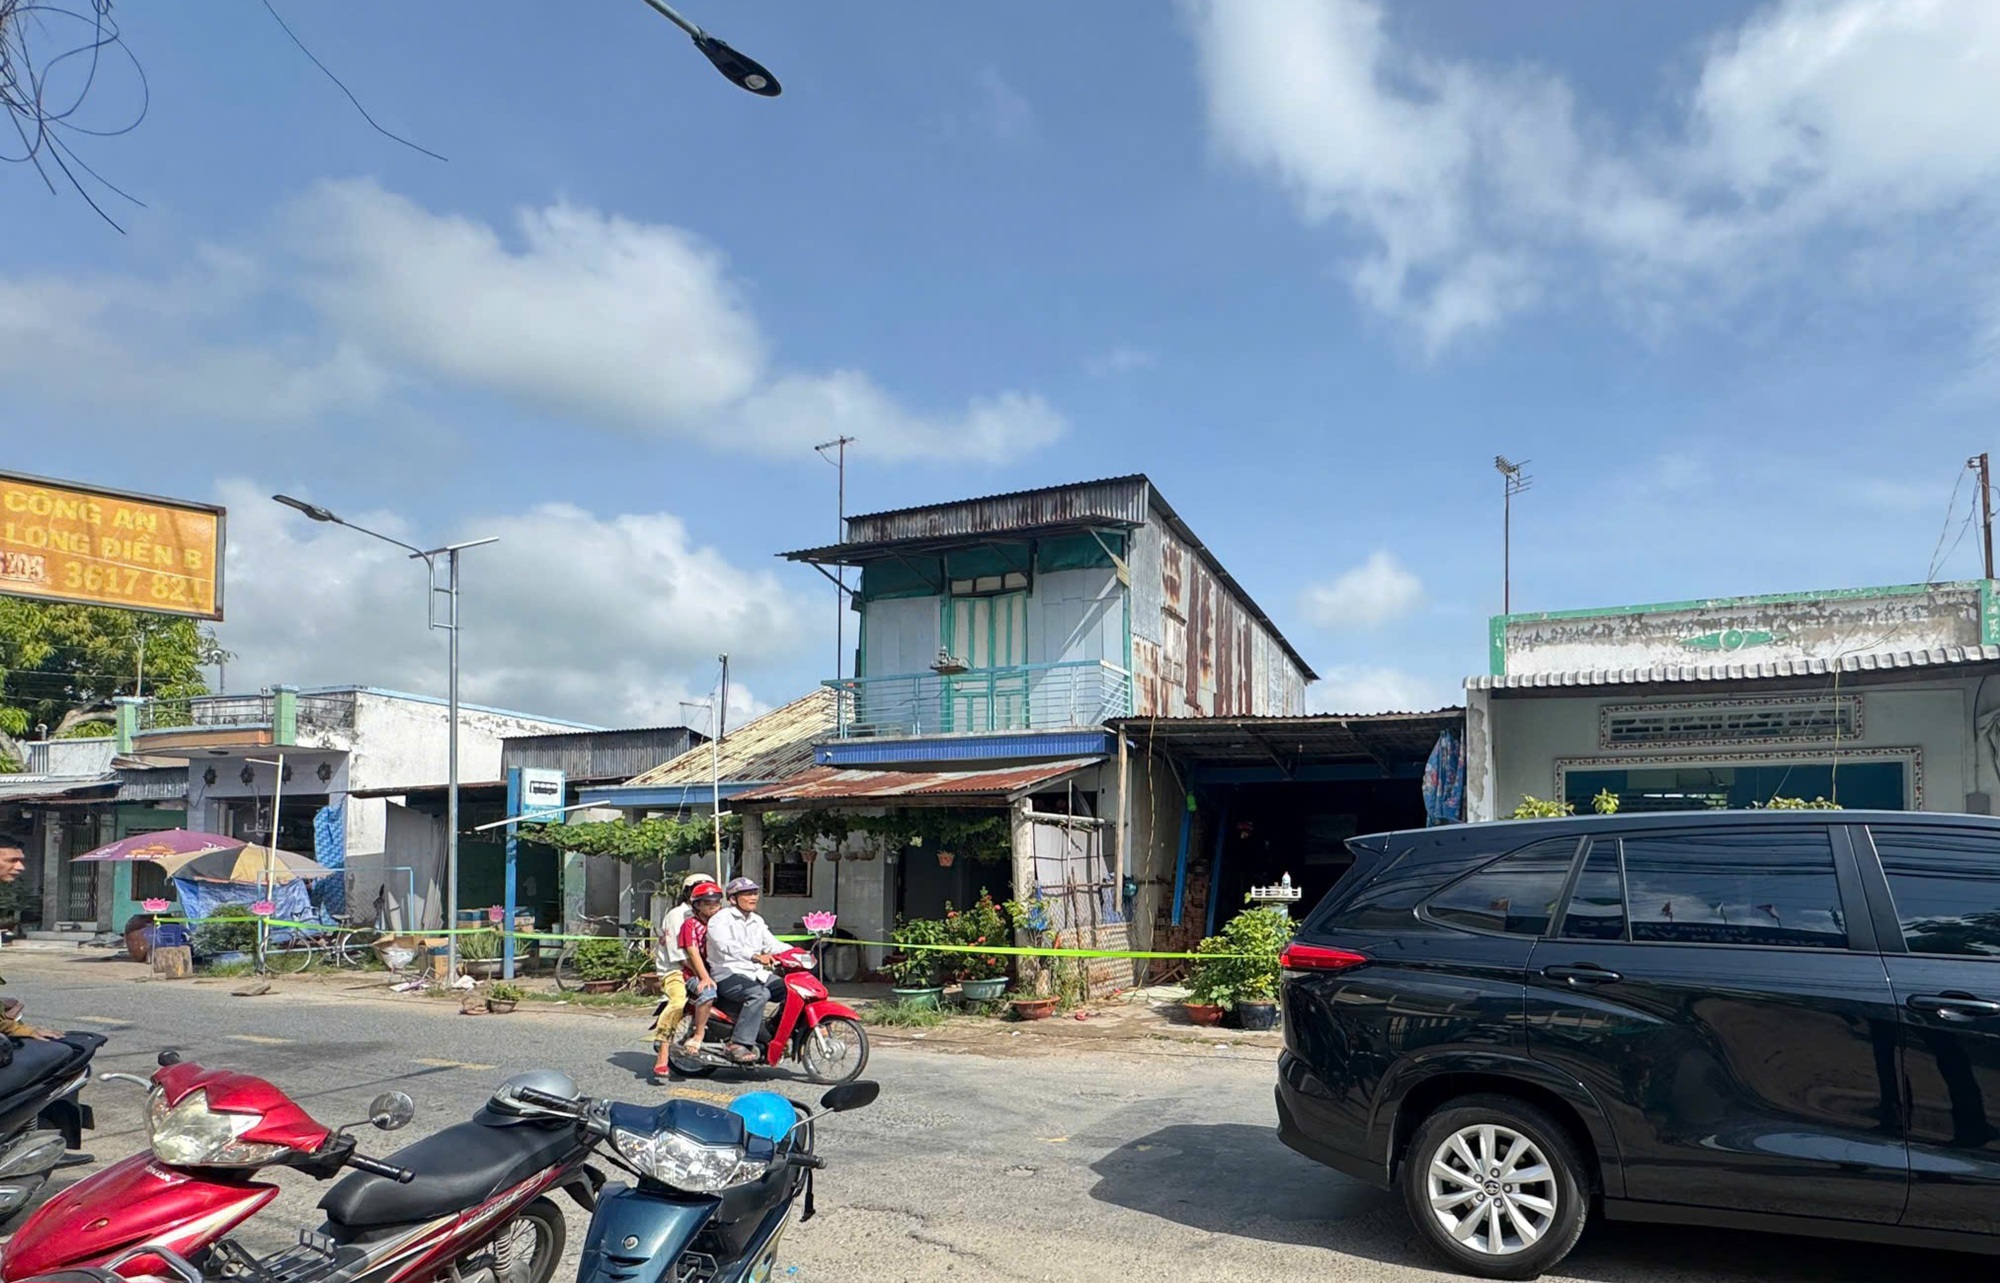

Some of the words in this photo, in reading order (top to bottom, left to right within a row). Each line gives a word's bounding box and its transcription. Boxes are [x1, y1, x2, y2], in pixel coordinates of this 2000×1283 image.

[4, 490, 101, 524] CÔNG
[113, 507, 157, 532] AN
[6, 522, 90, 553] LONG
[184, 548, 203, 570] B
[64, 561, 141, 595] 3617
[150, 572, 204, 603] 821
